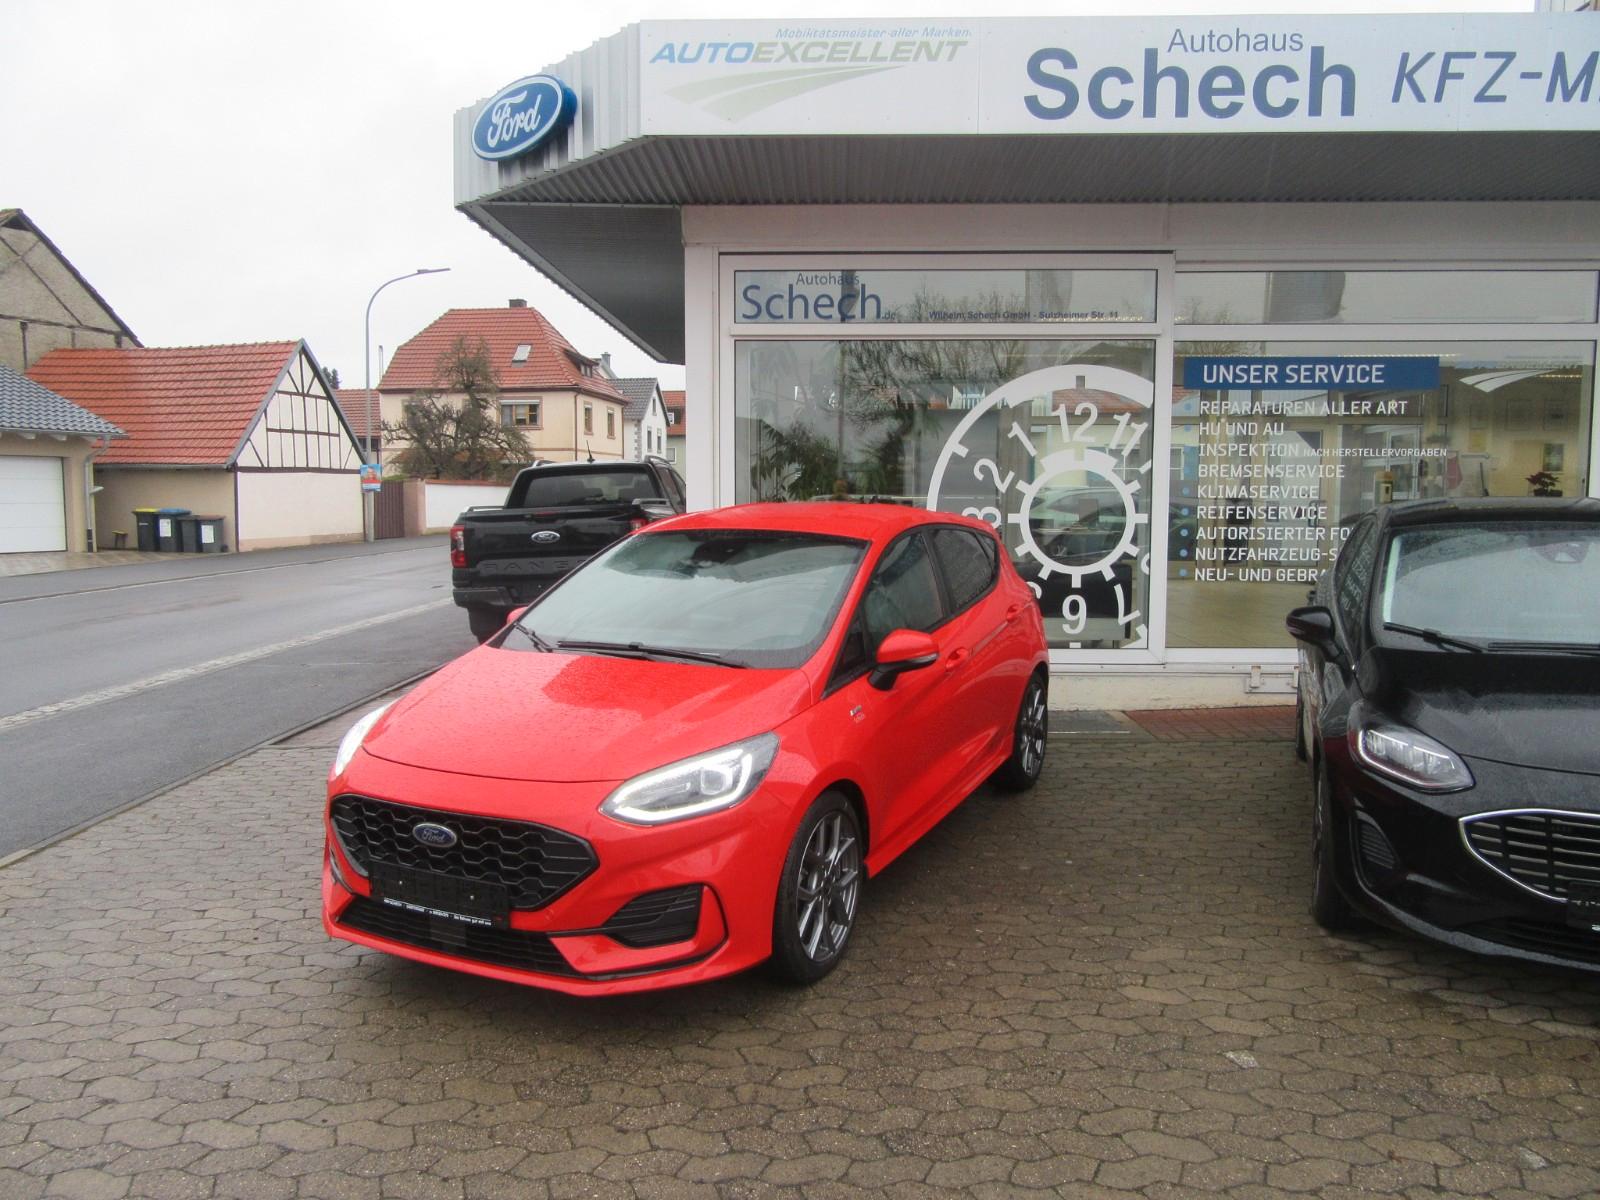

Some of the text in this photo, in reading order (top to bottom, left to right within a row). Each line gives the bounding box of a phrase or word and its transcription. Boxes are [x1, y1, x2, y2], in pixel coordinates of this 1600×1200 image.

[890, 28, 919, 39] aller
[1167, 28, 1304, 53] Autohaus
[648, 41, 968, 64] AUTOEXCELLENT
[1023, 46, 1357, 120] Schech
[1391, 50, 1600, 103] KFZ-M
[487, 91, 541, 148] Ford
[795, 273, 860, 286] Autohaus
[929, 310, 964, 320] Wilhelm
[967, 310, 1001, 320] Schech
[1002, 310, 1030, 320] GmbH
[1203, 364, 1385, 384] UNSER SERVICE
[1200, 401, 1408, 415] REPARATUREN ALLER ART
[1052, 403, 1099, 443] 12
[1199, 422, 1285, 436] HU UND AU
[1198, 443, 1447, 457] INSPEKTION NACH HERSTELLERVORGABEN
[1198, 464, 1345, 478] BREMSENSERVICE
[1197, 485, 1320, 499] KLIMASERVICE
[1196, 506, 1328, 520] REIFENSERVICE
[1196, 527, 1354, 541] AUTORISIERTER FO
[1195, 548, 1337, 561] NUTZFAHRZEUG-S
[1194, 568, 1234, 582] NEU-
[1239, 568, 1270, 582] UND
